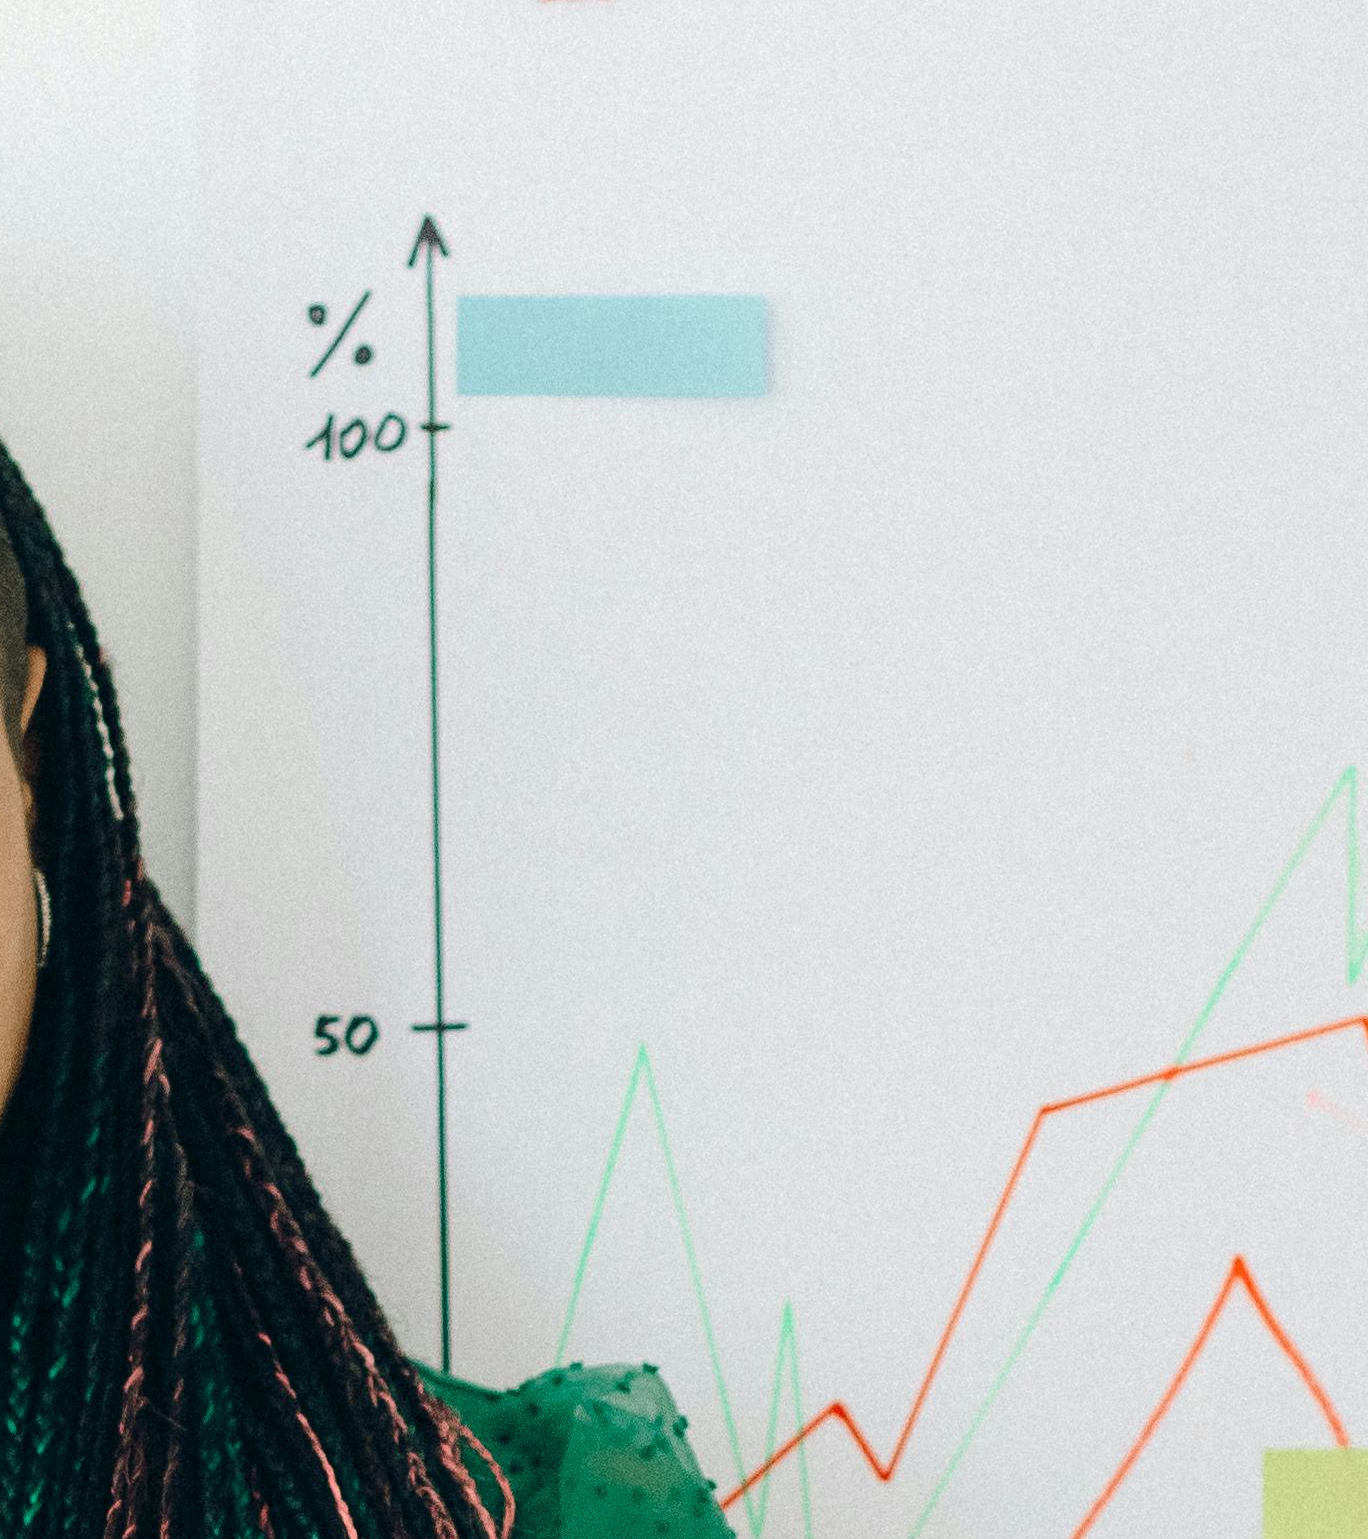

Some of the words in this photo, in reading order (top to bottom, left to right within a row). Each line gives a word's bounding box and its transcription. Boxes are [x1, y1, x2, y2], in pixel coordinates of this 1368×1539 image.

[307, 289, 372, 378] %
[305, 412, 408, 461] 100
[314, 1014, 381, 1056] 50
